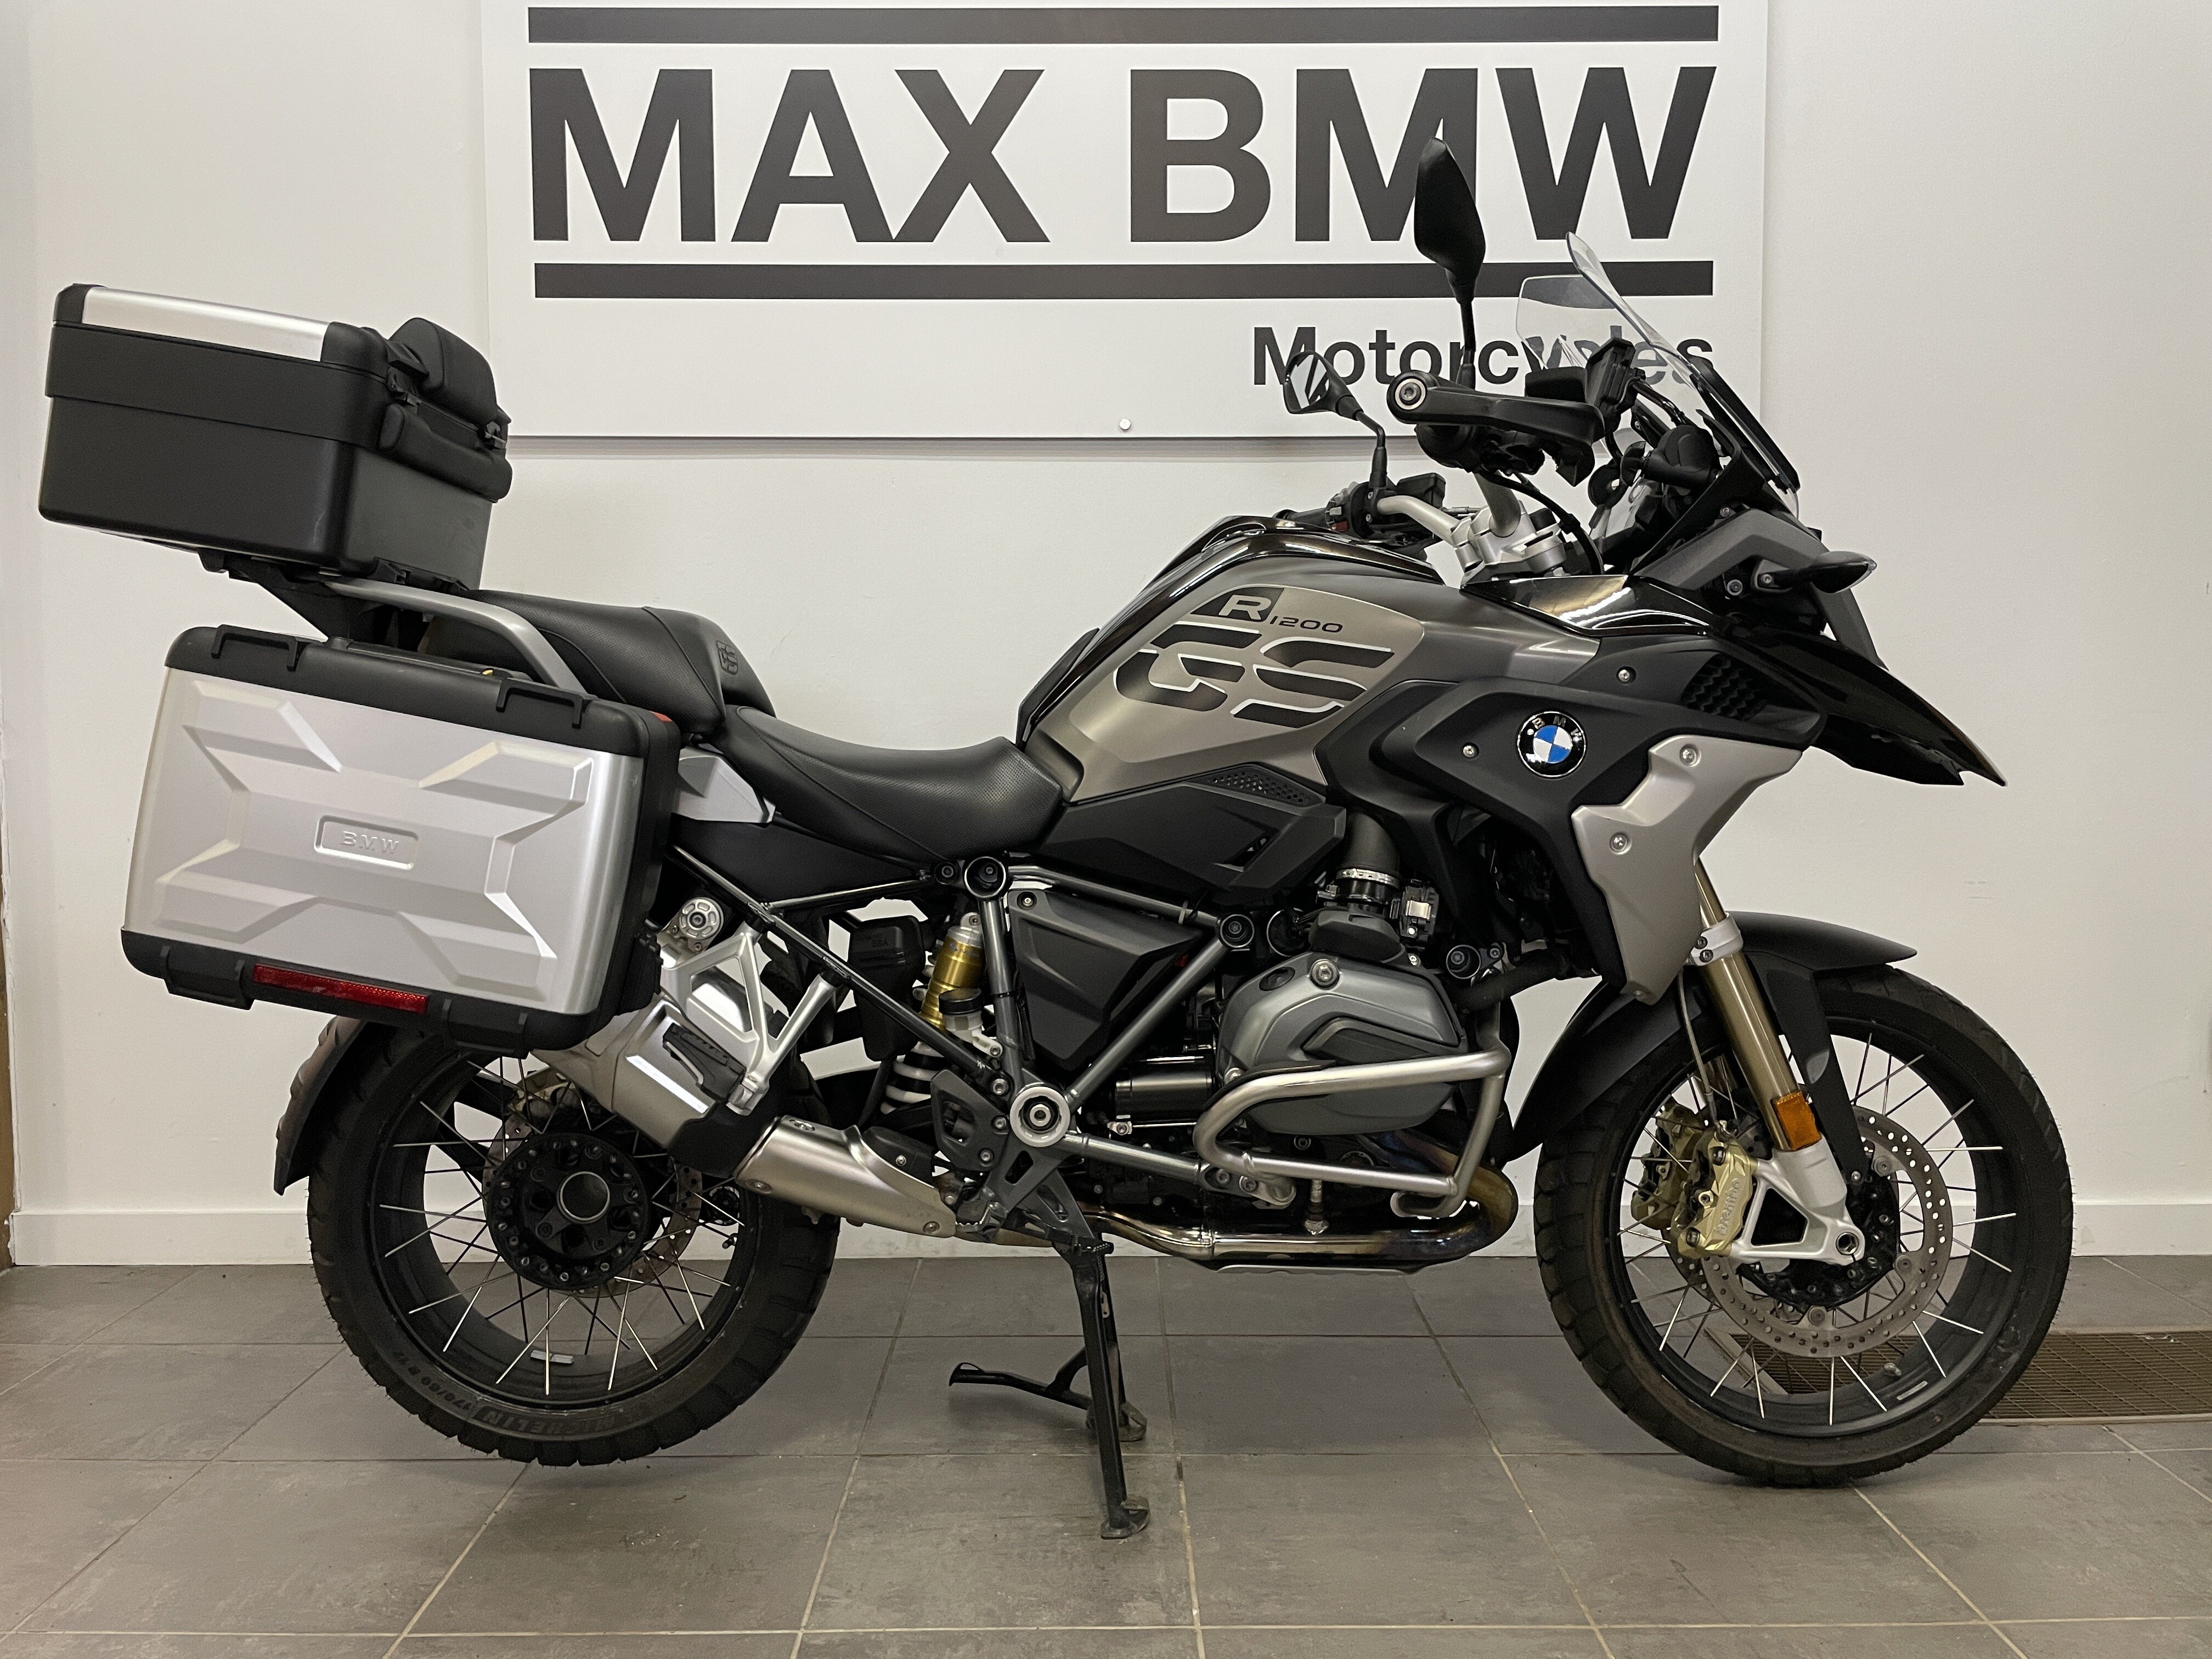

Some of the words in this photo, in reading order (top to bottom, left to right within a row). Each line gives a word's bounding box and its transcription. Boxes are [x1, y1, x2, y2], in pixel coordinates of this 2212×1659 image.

[529, 68, 1051, 242] MAX
[1130, 66, 1717, 242] BMW
[1254, 326, 1713, 386] Motorcyes
[1218, 594, 1272, 620] R
[1269, 616, 1344, 633] 1200
[1113, 620, 1395, 729] GS
[1531, 715, 1583, 743] BMW
[341, 831, 400, 854] BMW
